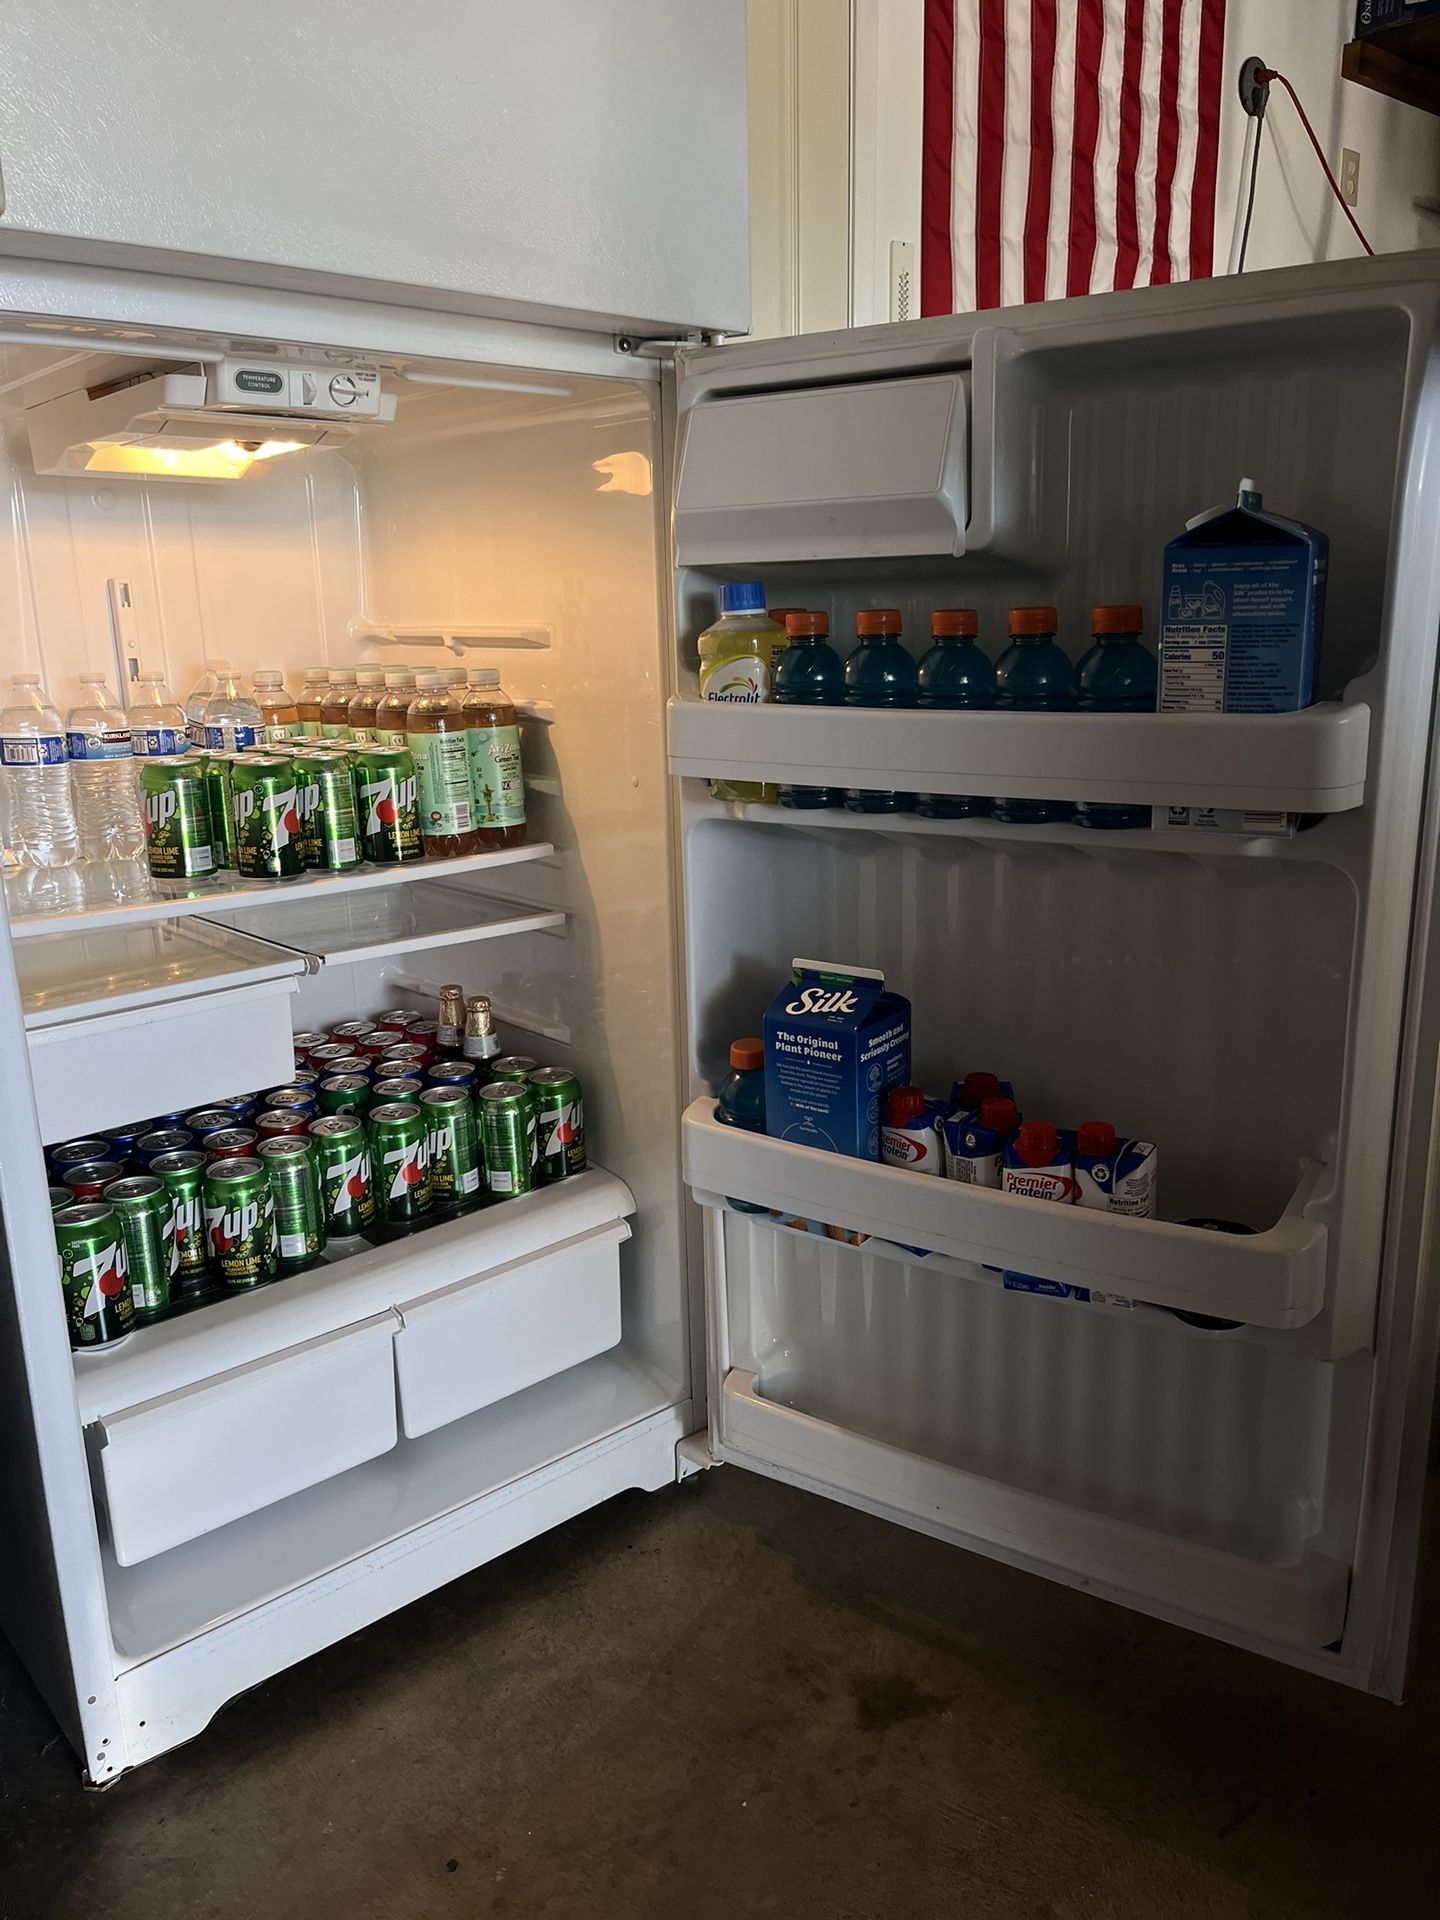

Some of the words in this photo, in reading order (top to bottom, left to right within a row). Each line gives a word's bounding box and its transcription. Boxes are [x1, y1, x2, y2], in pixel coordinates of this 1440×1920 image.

[242, 374, 277, 384] TEMPERATURE
[247, 382, 272, 390] CONTROL
[1212, 651, 1225, 660] 50
[495, 755, 512, 764] Green
[360, 774, 417, 837] 7up
[163, 846, 180, 856] LIME
[784, 987, 860, 1016] Silk
[776, 1030, 796, 1042] The
[796, 1034, 839, 1050] Original
[868, 1029, 893, 1048] Smooth
[892, 1023, 905, 1037] and
[775, 1041, 803, 1054] Plant
[803, 1046, 843, 1062] Pioneer
[860, 1042, 890, 1063] Seriously
[889, 1031, 910, 1049] Creamy
[1006, 1173, 1059, 1190] Premier
[1008, 1184, 1054, 1200] Protein
[1109, 1197, 1140, 1206] Nutrition
[203, 1201, 258, 1258] 7up
[179, 1249, 198, 1258] EMON
[221, 1258, 245, 1268] LEMON
[245, 1254, 262, 1266] LIME
